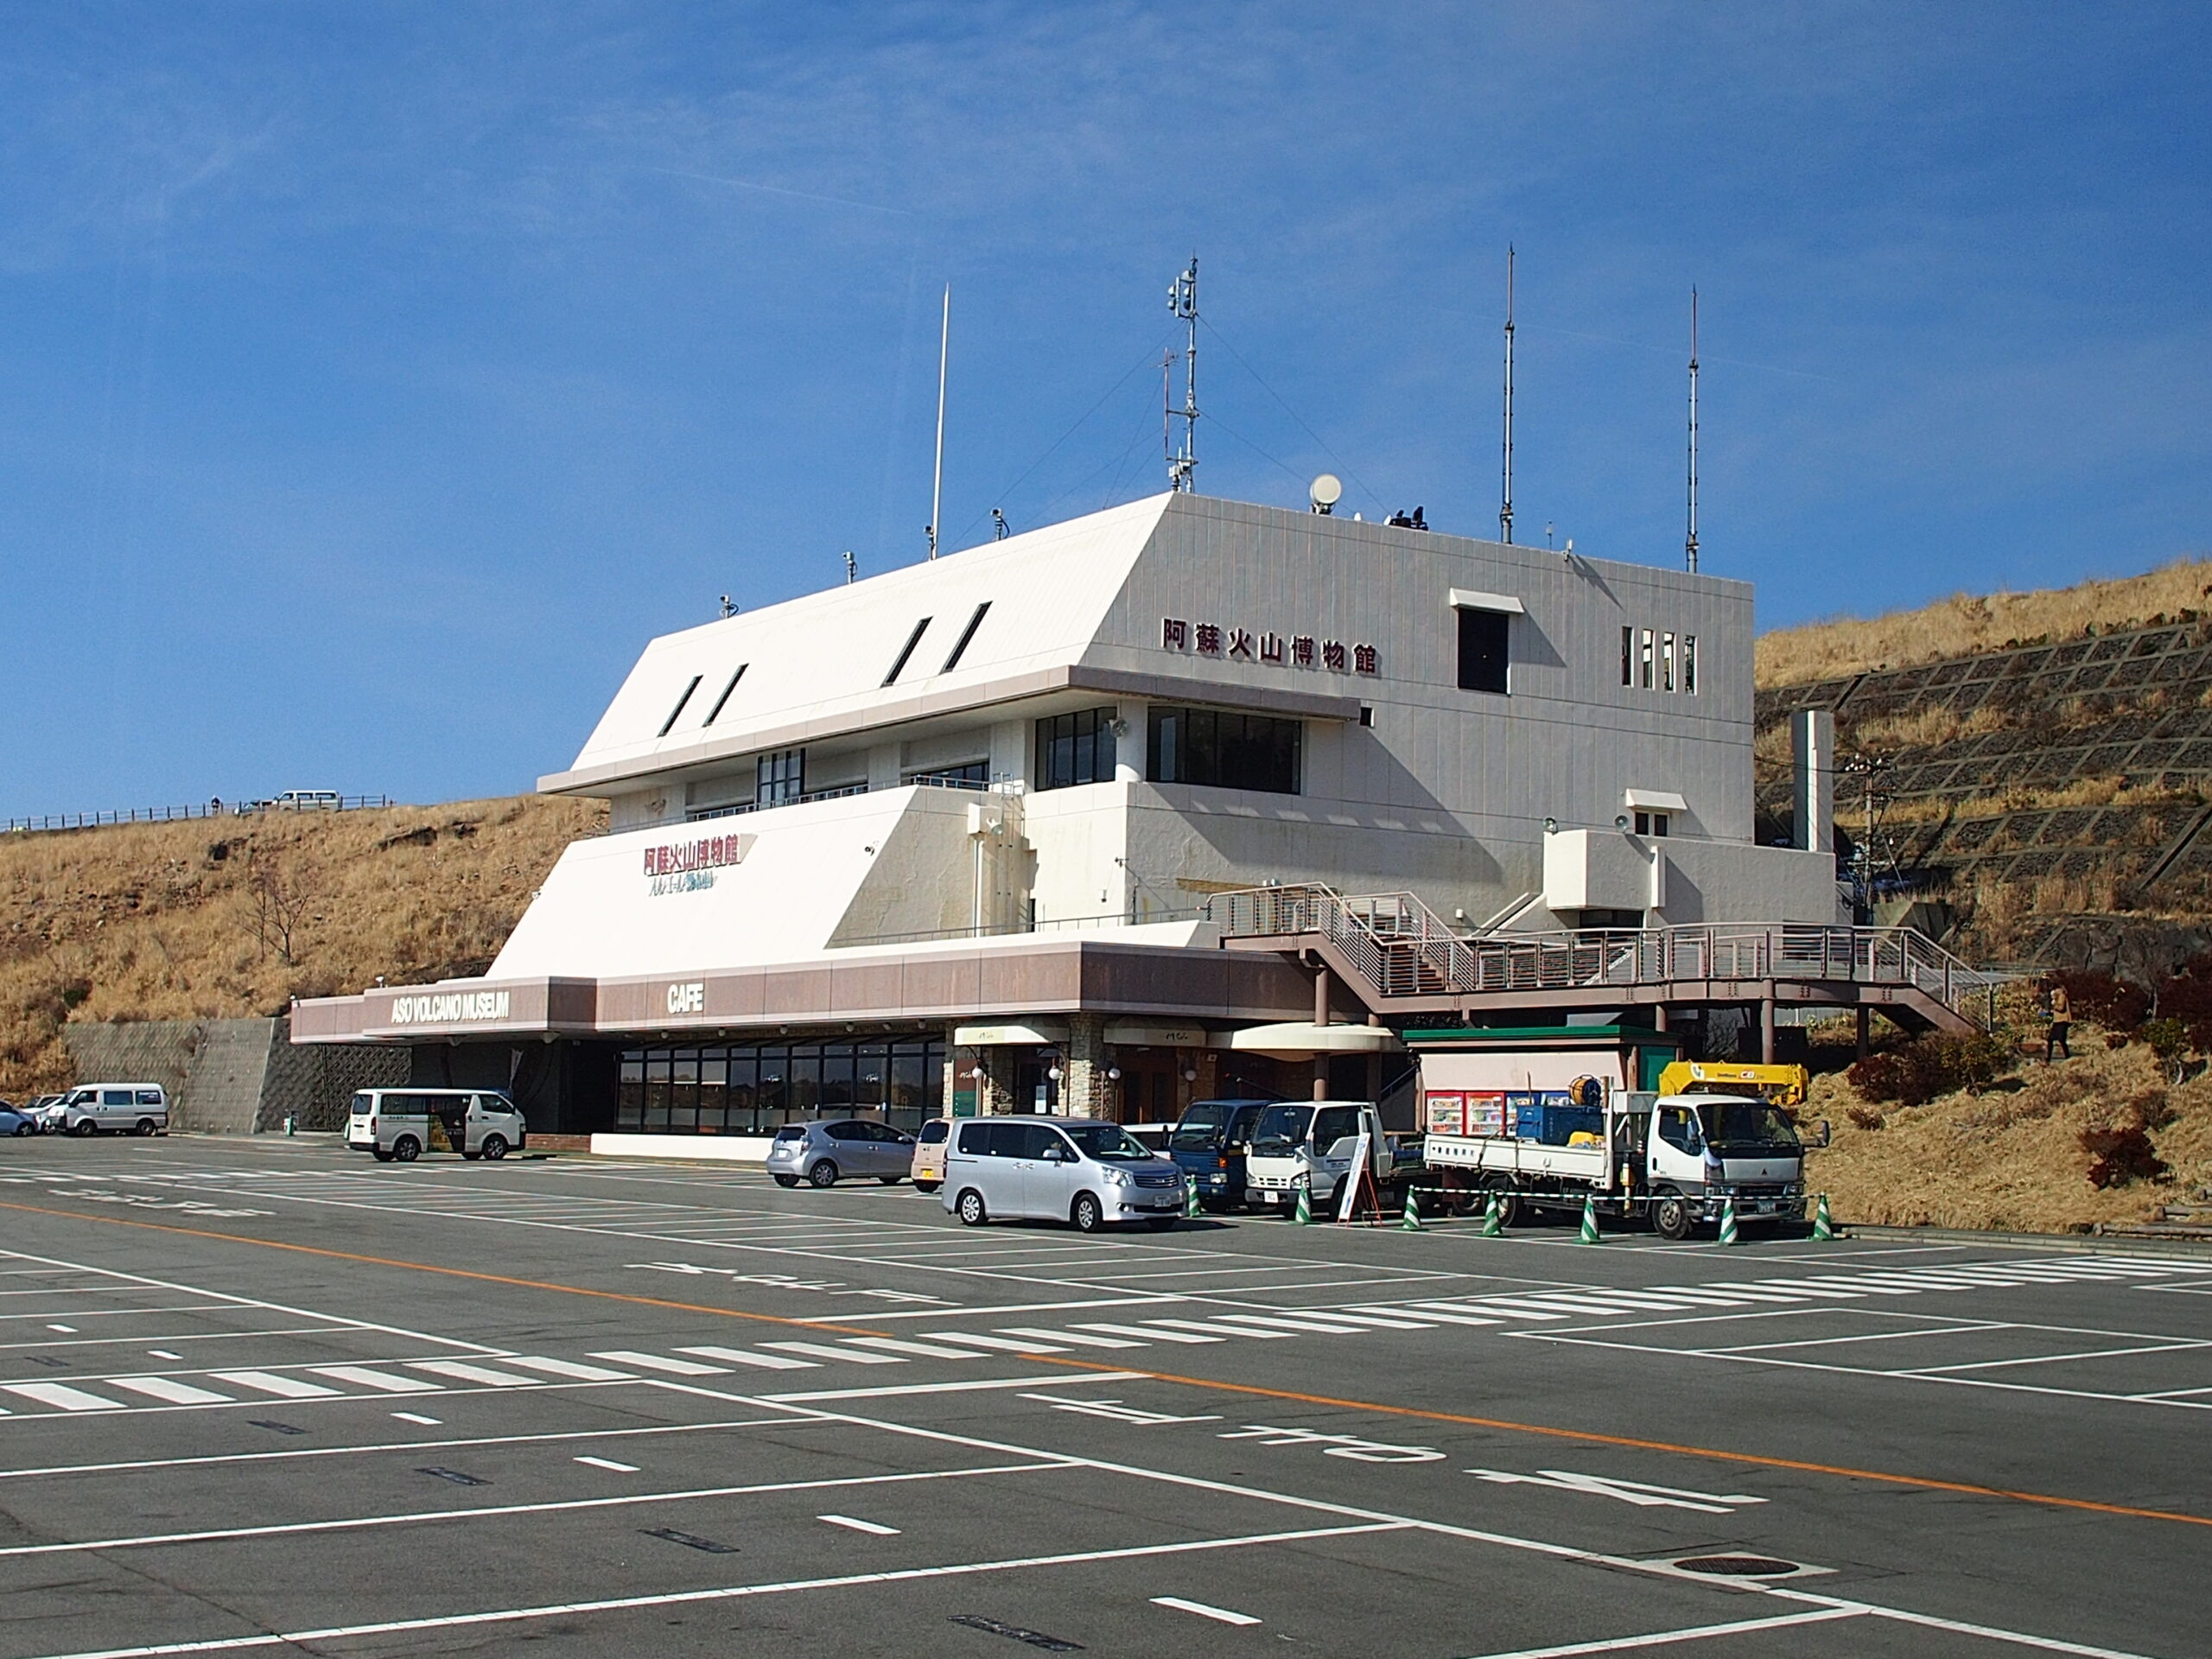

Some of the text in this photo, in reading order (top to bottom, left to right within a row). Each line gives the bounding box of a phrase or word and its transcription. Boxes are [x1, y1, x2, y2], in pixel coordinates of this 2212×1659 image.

[1163, 618, 1377, 673] 阿蘇火山博物館
[644, 834, 739, 875] 阿蘇火山博物館
[391, 991, 510, 1024] ASO VOLCANO MUSEUM
[667, 983, 705, 1014] CAFE
